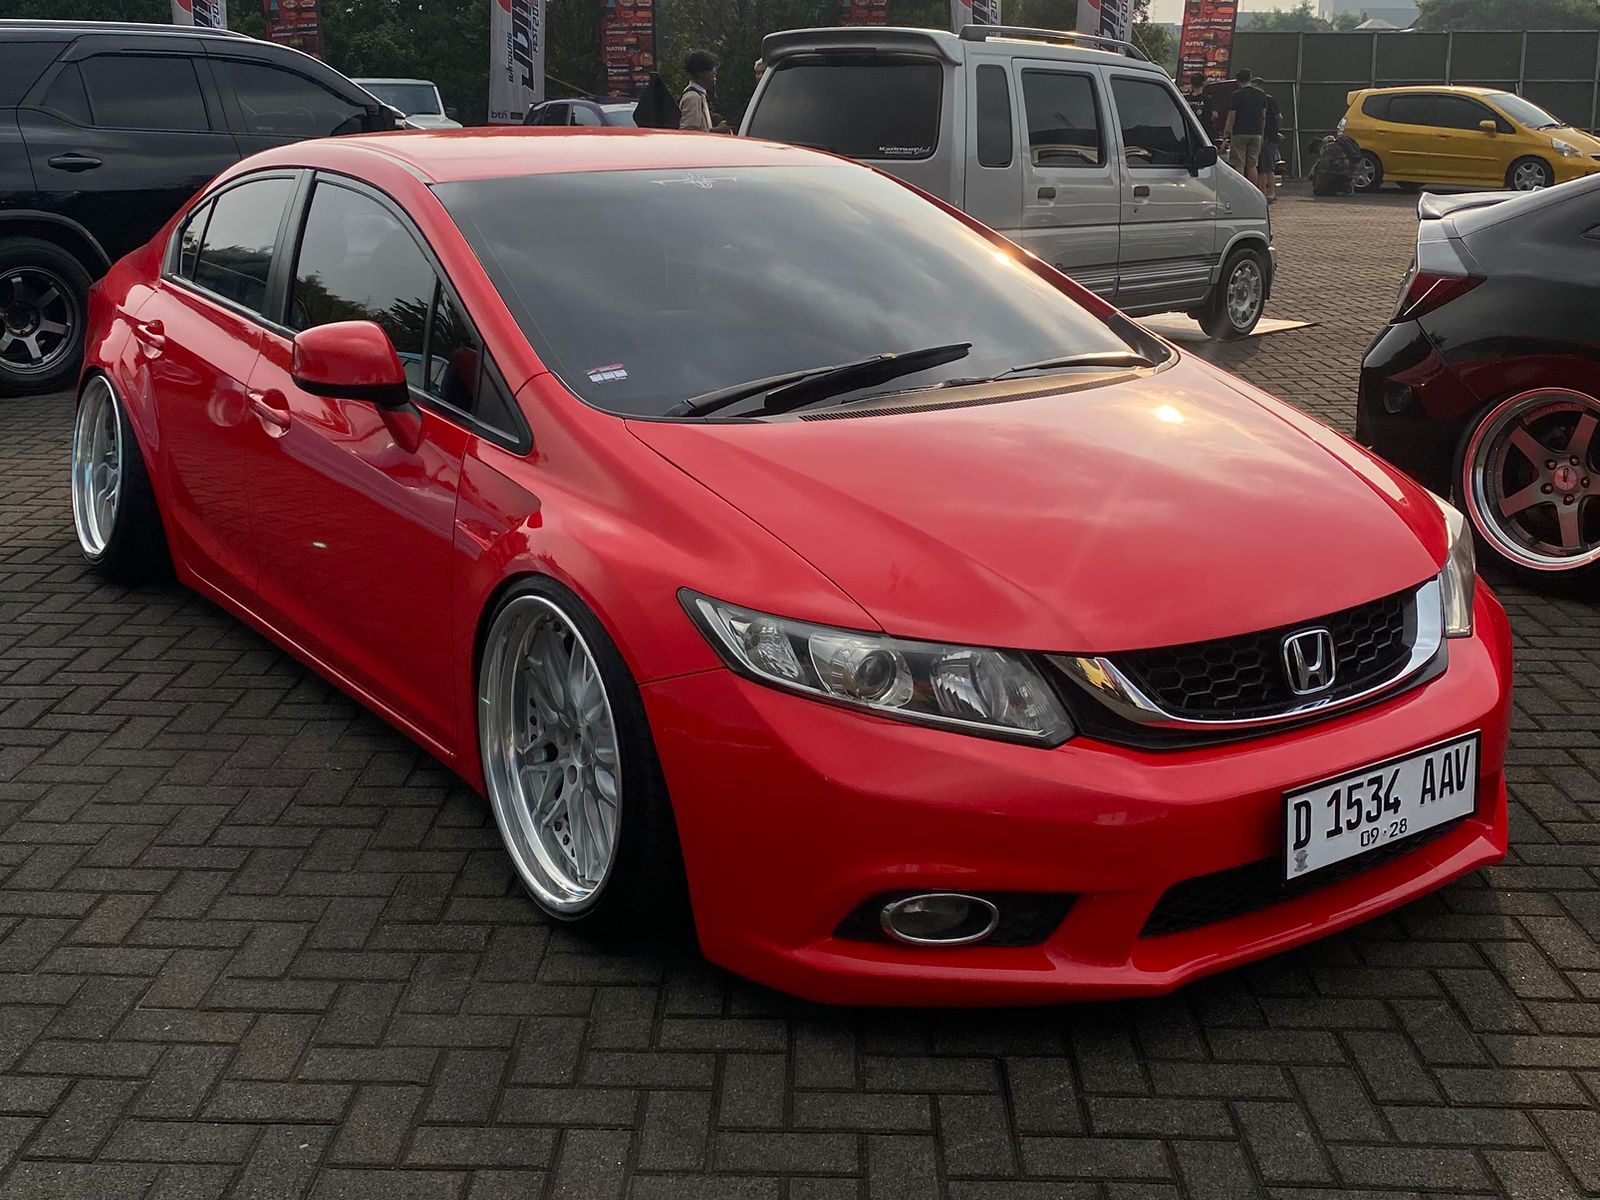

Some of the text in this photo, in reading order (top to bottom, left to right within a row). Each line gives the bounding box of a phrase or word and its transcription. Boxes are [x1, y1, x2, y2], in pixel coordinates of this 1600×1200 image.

[1293, 745, 1471, 851] D 1534 AAV
